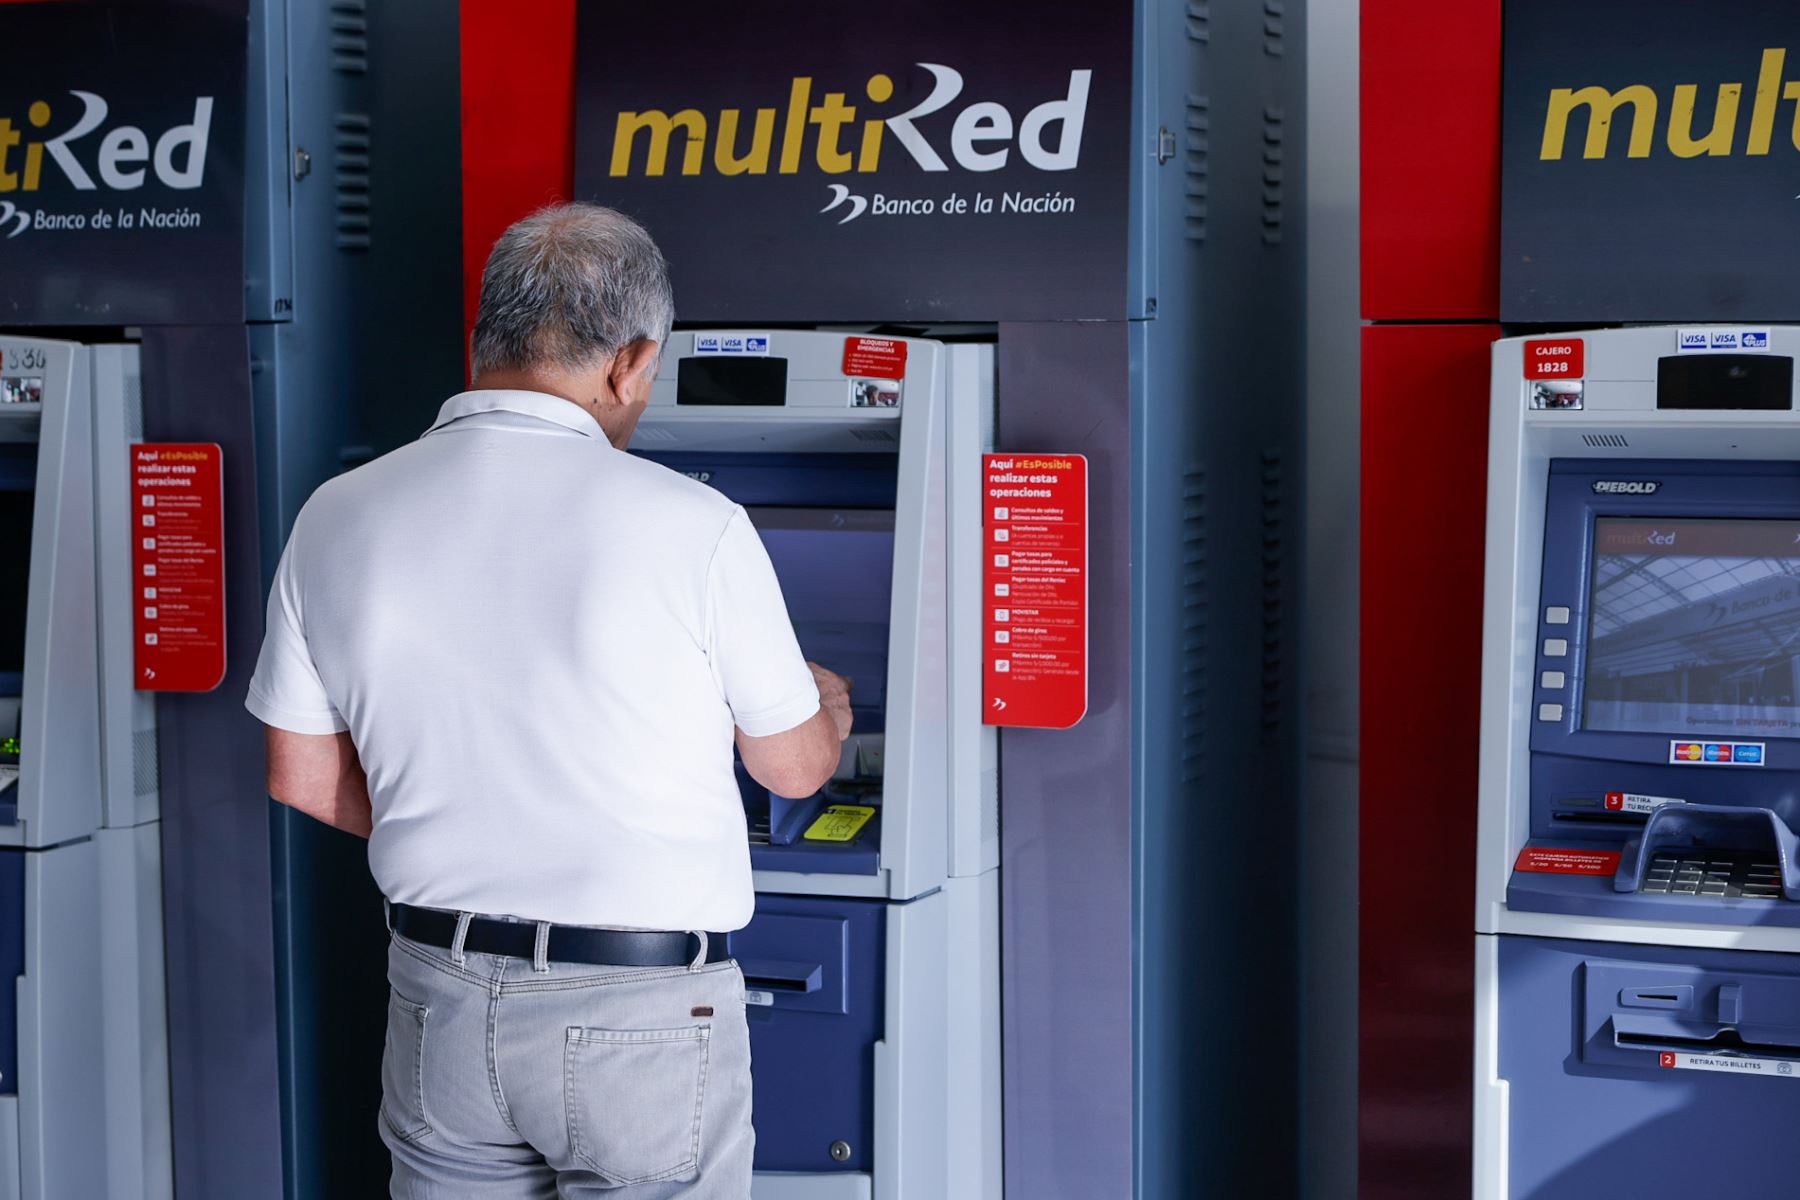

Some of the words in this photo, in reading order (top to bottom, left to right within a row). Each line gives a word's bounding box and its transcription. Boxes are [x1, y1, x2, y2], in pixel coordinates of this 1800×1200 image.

[609, 62, 1092, 177] multiRed
[871, 194, 934, 214] Banco
[941, 193, 967, 214] de
[974, 192, 993, 213] la
[1001, 192, 1075, 213] Nación
[34, 209, 86, 230] Banco
[91, 208, 112, 228] de
[118, 208, 133, 228] la
[140, 207, 201, 228] Nación
[860, 339, 889, 347] BLOQUEOS
[857, 345, 895, 353] EMERGENCIAS
[1536, 346, 1571, 356] CAJERO
[1537, 362, 1568, 373] 1828
[172, 465, 196, 474] estas
[990, 459, 1014, 470] Aquí
[1016, 460, 1072, 469] #EsPosible
[138, 476, 192, 487] operaciones
[990, 472, 1027, 483] realizar
[1029, 474, 1058, 483] estas
[1593, 481, 1657, 493] DIEBOLD
[990, 487, 1052, 499] operaciones
[1611, 796, 1618, 805] 3
[1665, 1056, 1672, 1064] 2
[1689, 1058, 1714, 1066] RETIRA
[1730, 1061, 1761, 1069] BILLETES
